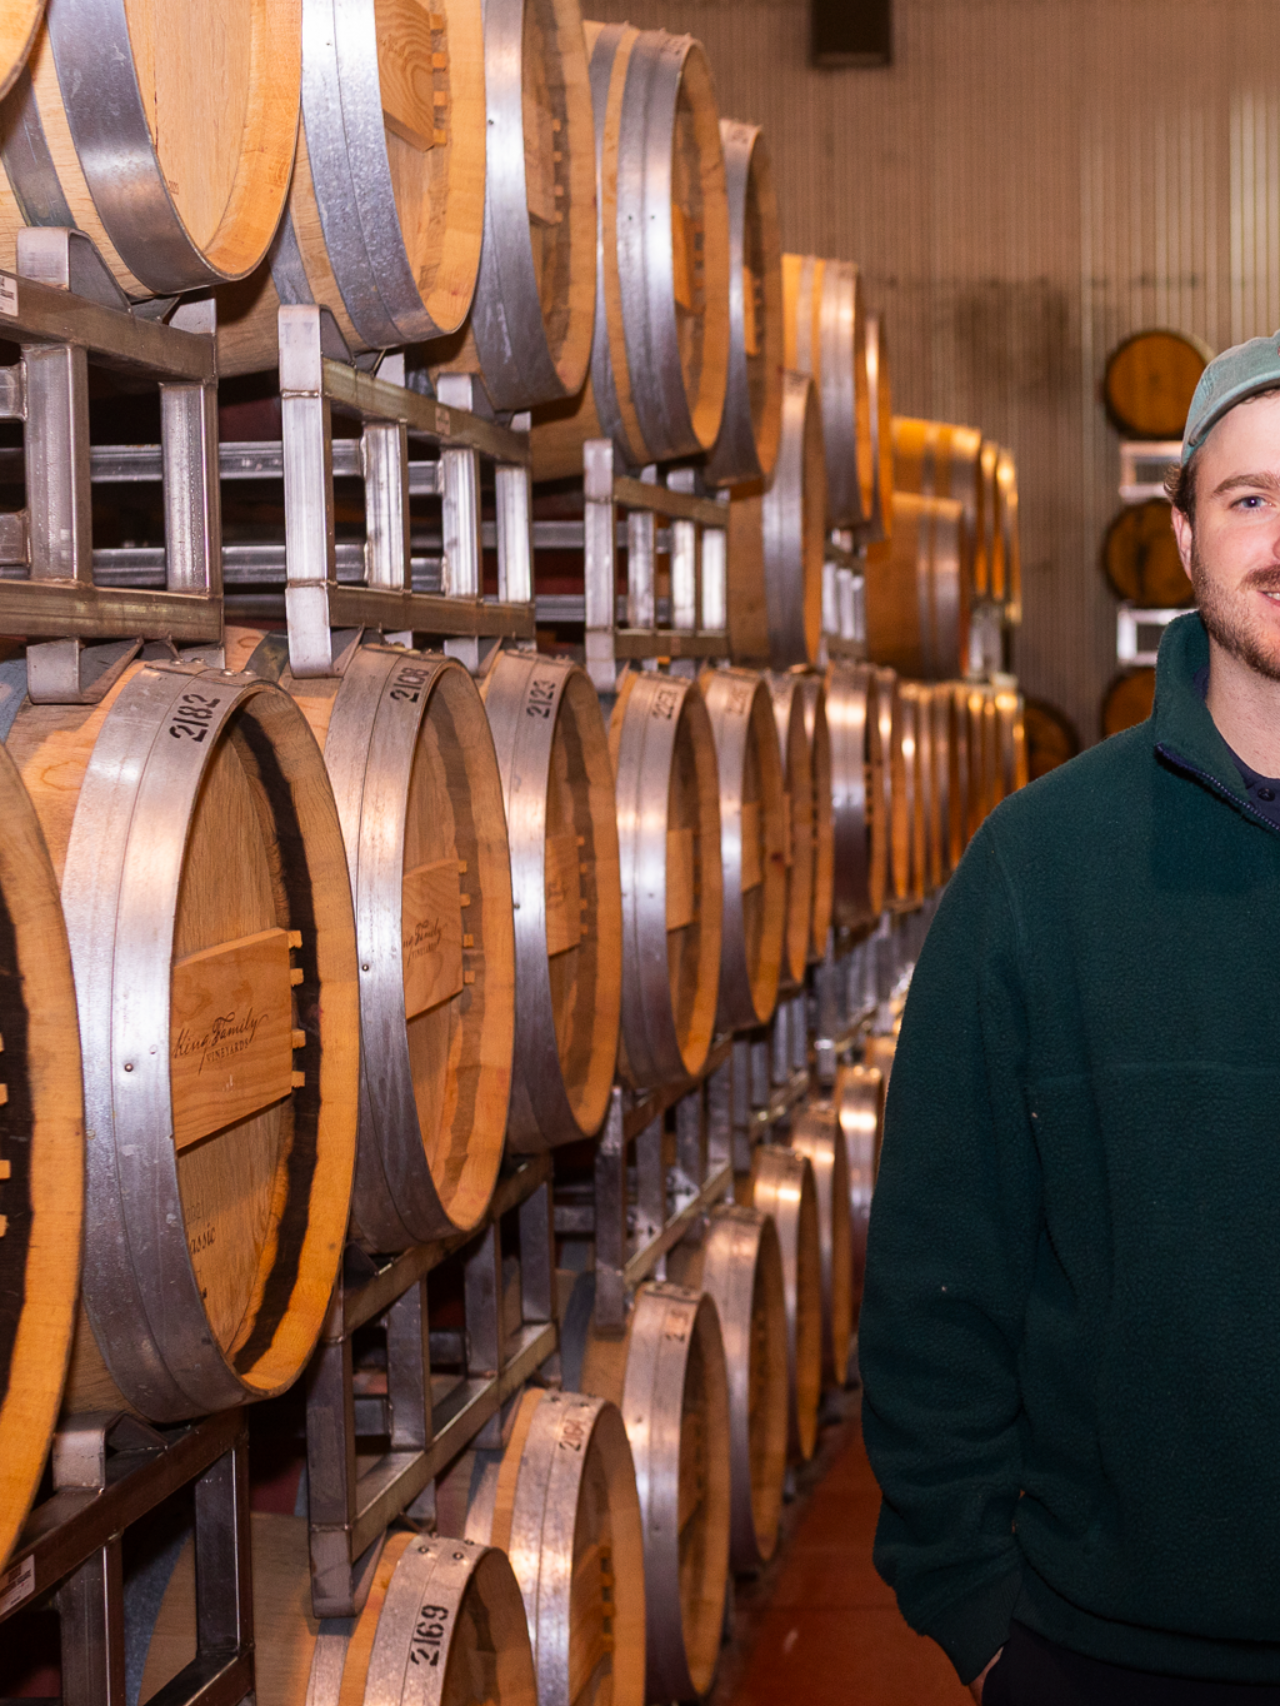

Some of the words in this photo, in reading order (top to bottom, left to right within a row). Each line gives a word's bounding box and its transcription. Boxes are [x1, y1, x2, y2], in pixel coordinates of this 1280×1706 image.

[390, 667, 430, 704] 2108
[526, 680, 556, 719] 2123
[169, 693, 221, 743] 2182
[174, 1027, 209, 1076] King
[211, 1006, 270, 1047] Family
[206, 1037, 249, 1063] VINEYARDS
[410, 1604, 449, 1667] 2169
